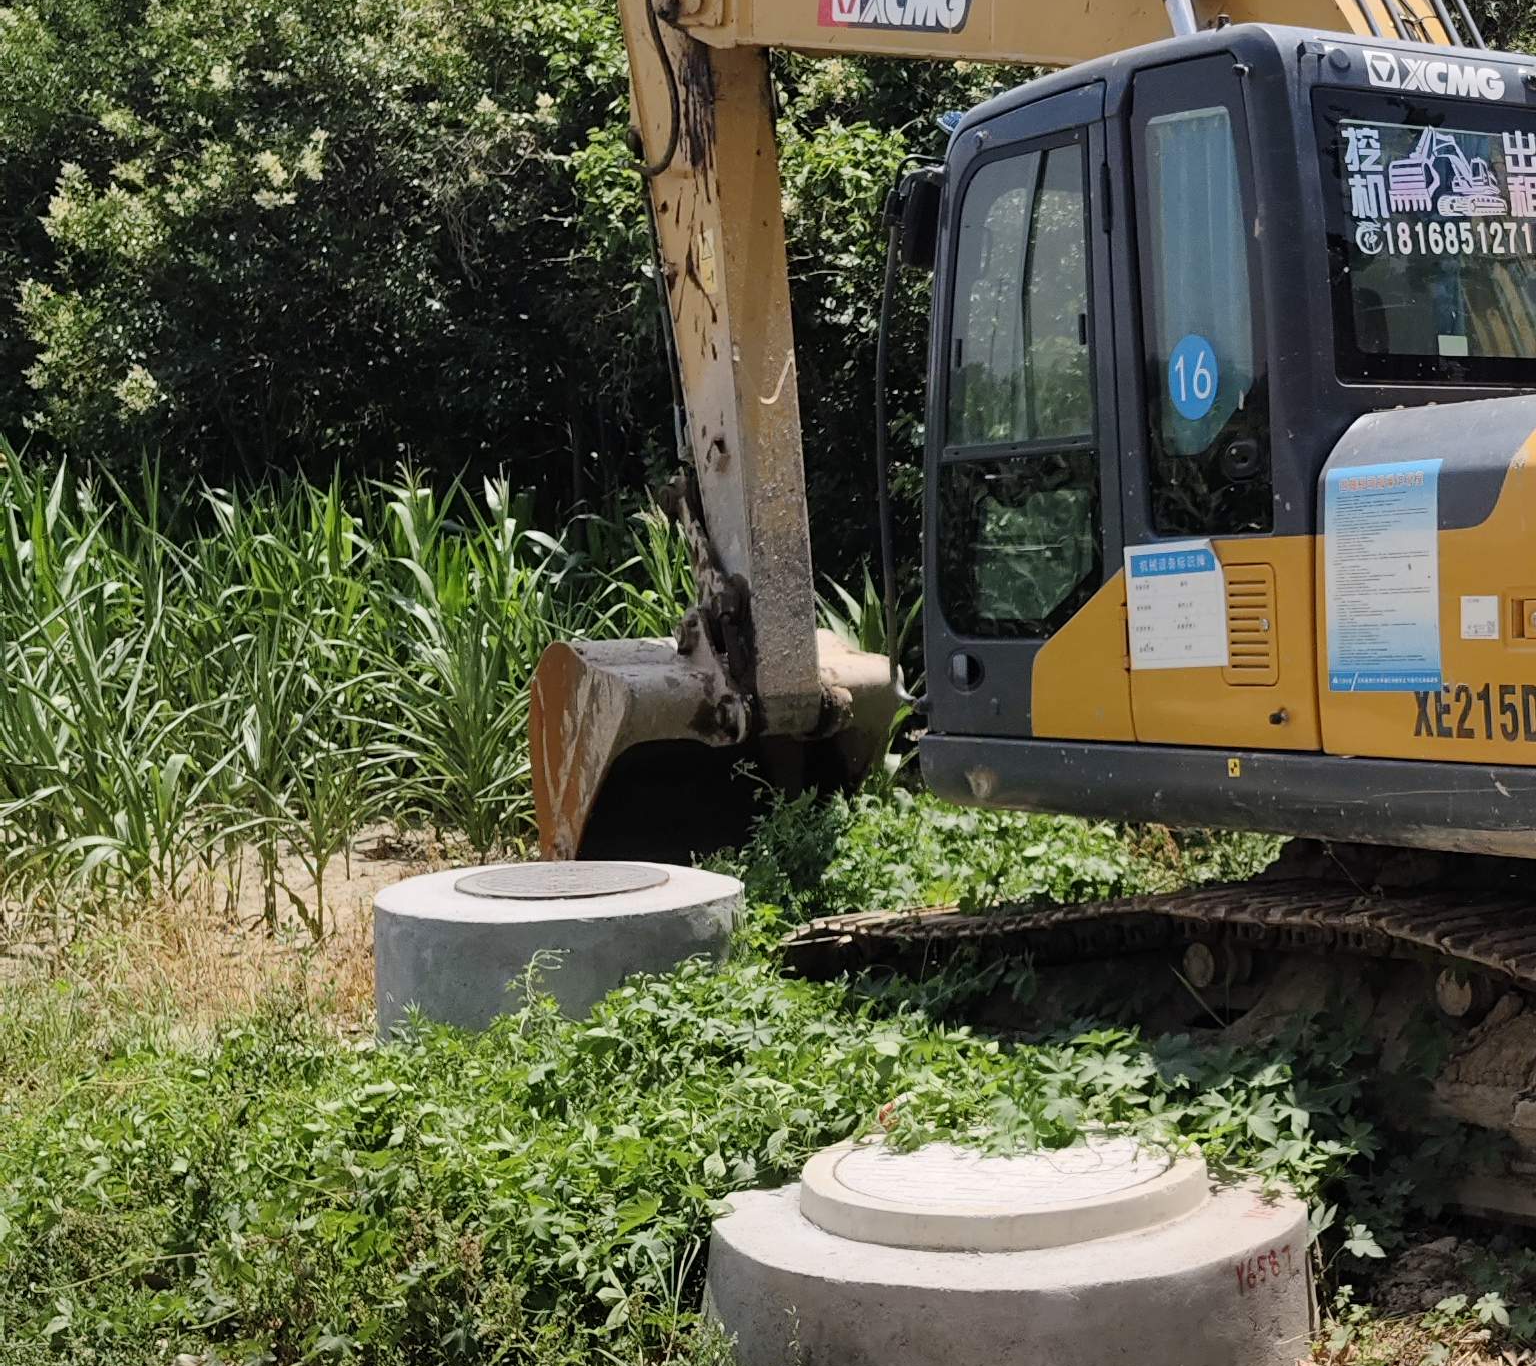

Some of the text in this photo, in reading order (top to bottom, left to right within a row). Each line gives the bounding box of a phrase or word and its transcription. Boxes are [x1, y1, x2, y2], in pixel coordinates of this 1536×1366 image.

[1400, 57, 1505, 101] XCMG
[1341, 127, 1390, 219] 挖机
[1175, 350, 1211, 401] 16
